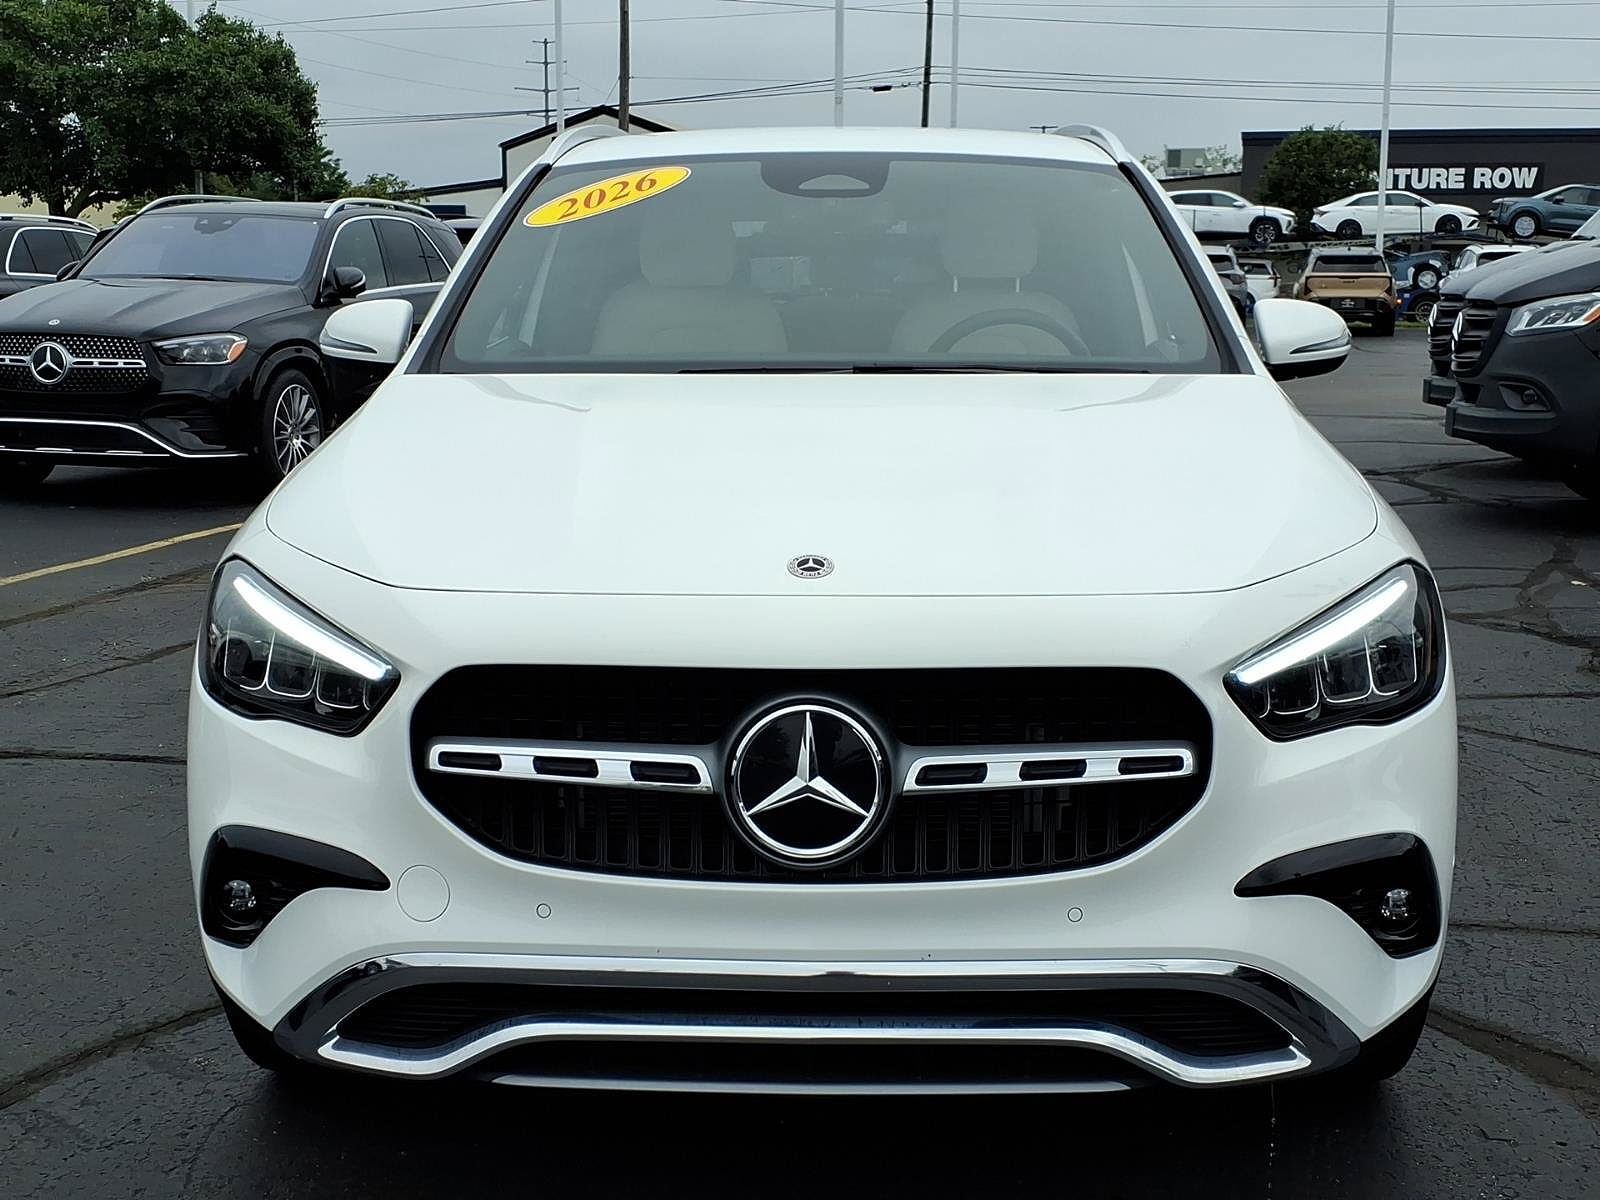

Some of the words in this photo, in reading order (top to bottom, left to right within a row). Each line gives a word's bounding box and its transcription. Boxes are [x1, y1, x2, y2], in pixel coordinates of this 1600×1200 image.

[556, 172, 657, 221] 2026
[1386, 167, 1465, 190] ITURE
[1473, 167, 1539, 189] ROW
